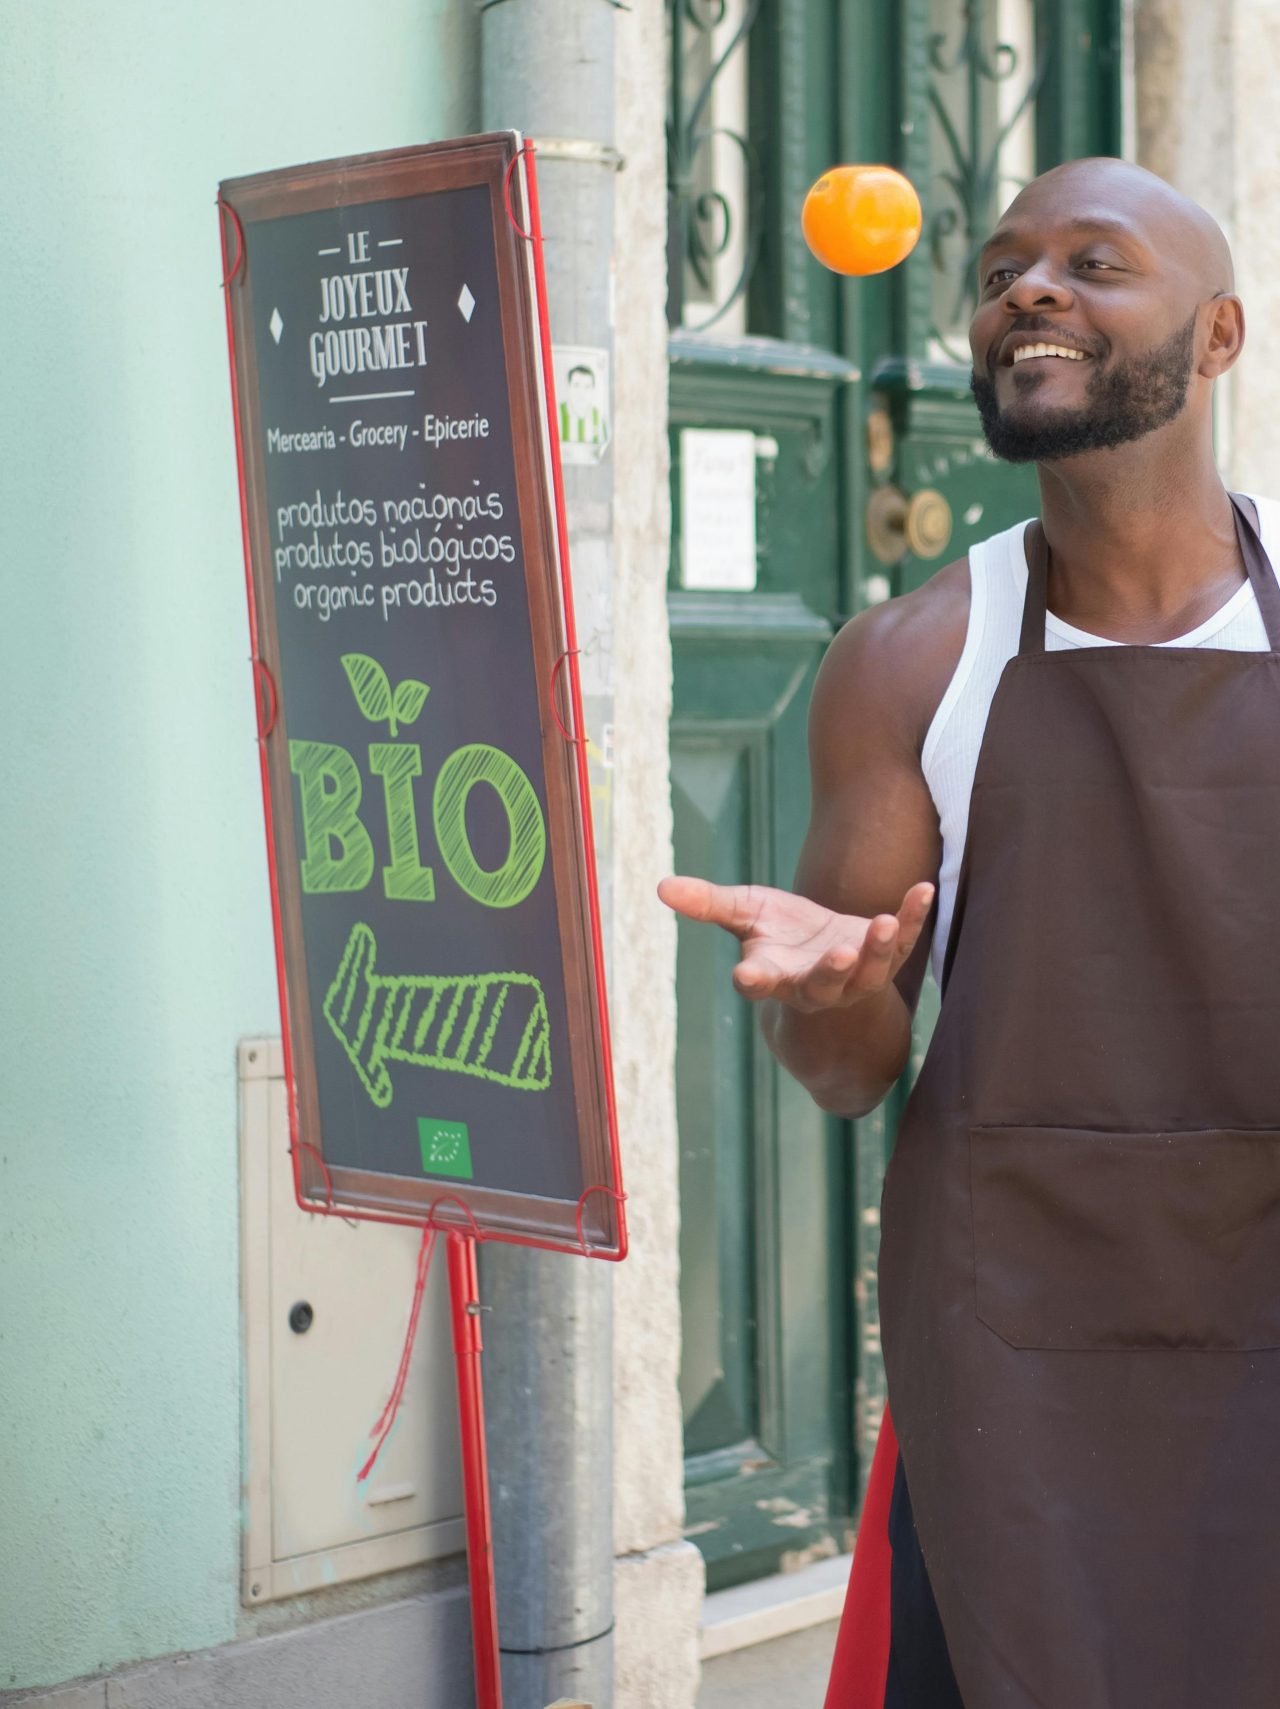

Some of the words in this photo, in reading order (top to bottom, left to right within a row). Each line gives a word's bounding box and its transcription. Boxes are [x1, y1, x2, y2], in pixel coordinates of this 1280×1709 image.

[347, 231, 371, 264] LE
[319, 267, 412, 323] JOYEUX
[309, 321, 428, 388] GOURMET
[267, 425, 336, 453] Mercearia
[350, 420, 408, 451] Grocery
[424, 413, 489, 448] Epicerie
[277, 489, 377, 542] produtos
[383, 479, 503, 525] nacionais
[275, 530, 374, 582] produtos
[380, 522, 515, 576] biológicos
[294, 570, 375, 621] organic
[381, 568, 497, 622] products
[289, 739, 546, 908] BIO
